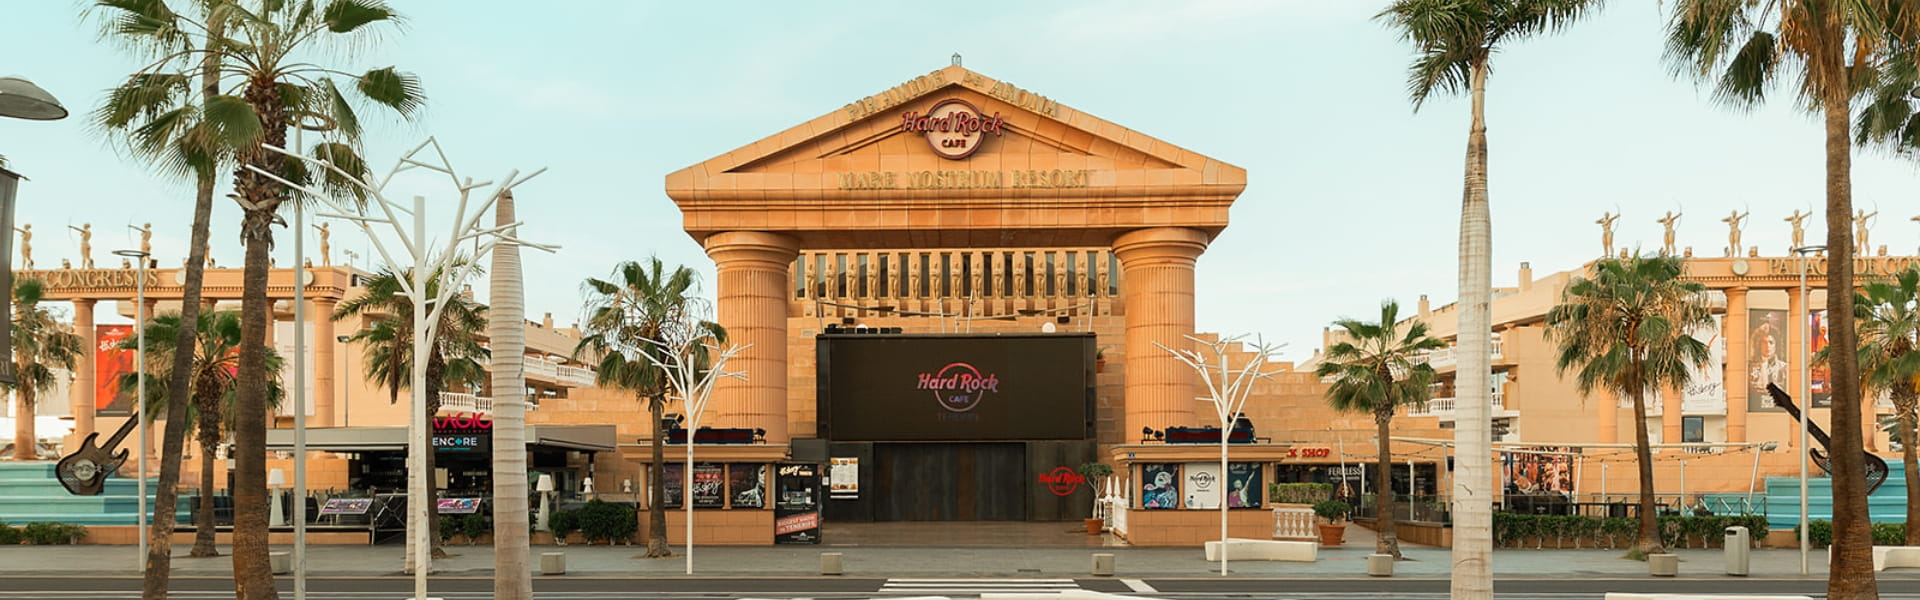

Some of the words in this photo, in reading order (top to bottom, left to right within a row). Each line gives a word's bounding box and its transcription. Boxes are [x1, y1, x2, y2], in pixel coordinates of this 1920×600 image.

[847, 69, 945, 121] PIRAMIDE
[986, 79, 1058, 118] ARONA
[901, 111, 951, 133] Hard
[954, 111, 1004, 136] Rock
[941, 139, 967, 149] CAFE
[838, 170, 894, 190] MARE
[906, 170, 1002, 190] NOSTRUM
[1010, 168, 1089, 189] RESORT
[1768, 258, 1828, 276] PALAC
[1852, 258, 1876, 275] DE
[45, 269, 158, 288] CONGRESOS
[917, 373, 959, 389] Hard
[960, 372, 999, 393] Rock
[432, 411, 493, 429] AGIC
[432, 436, 478, 446] ENCORE
[1301, 447, 1331, 457] SHOP
[1328, 466, 1362, 476] FEALESS
